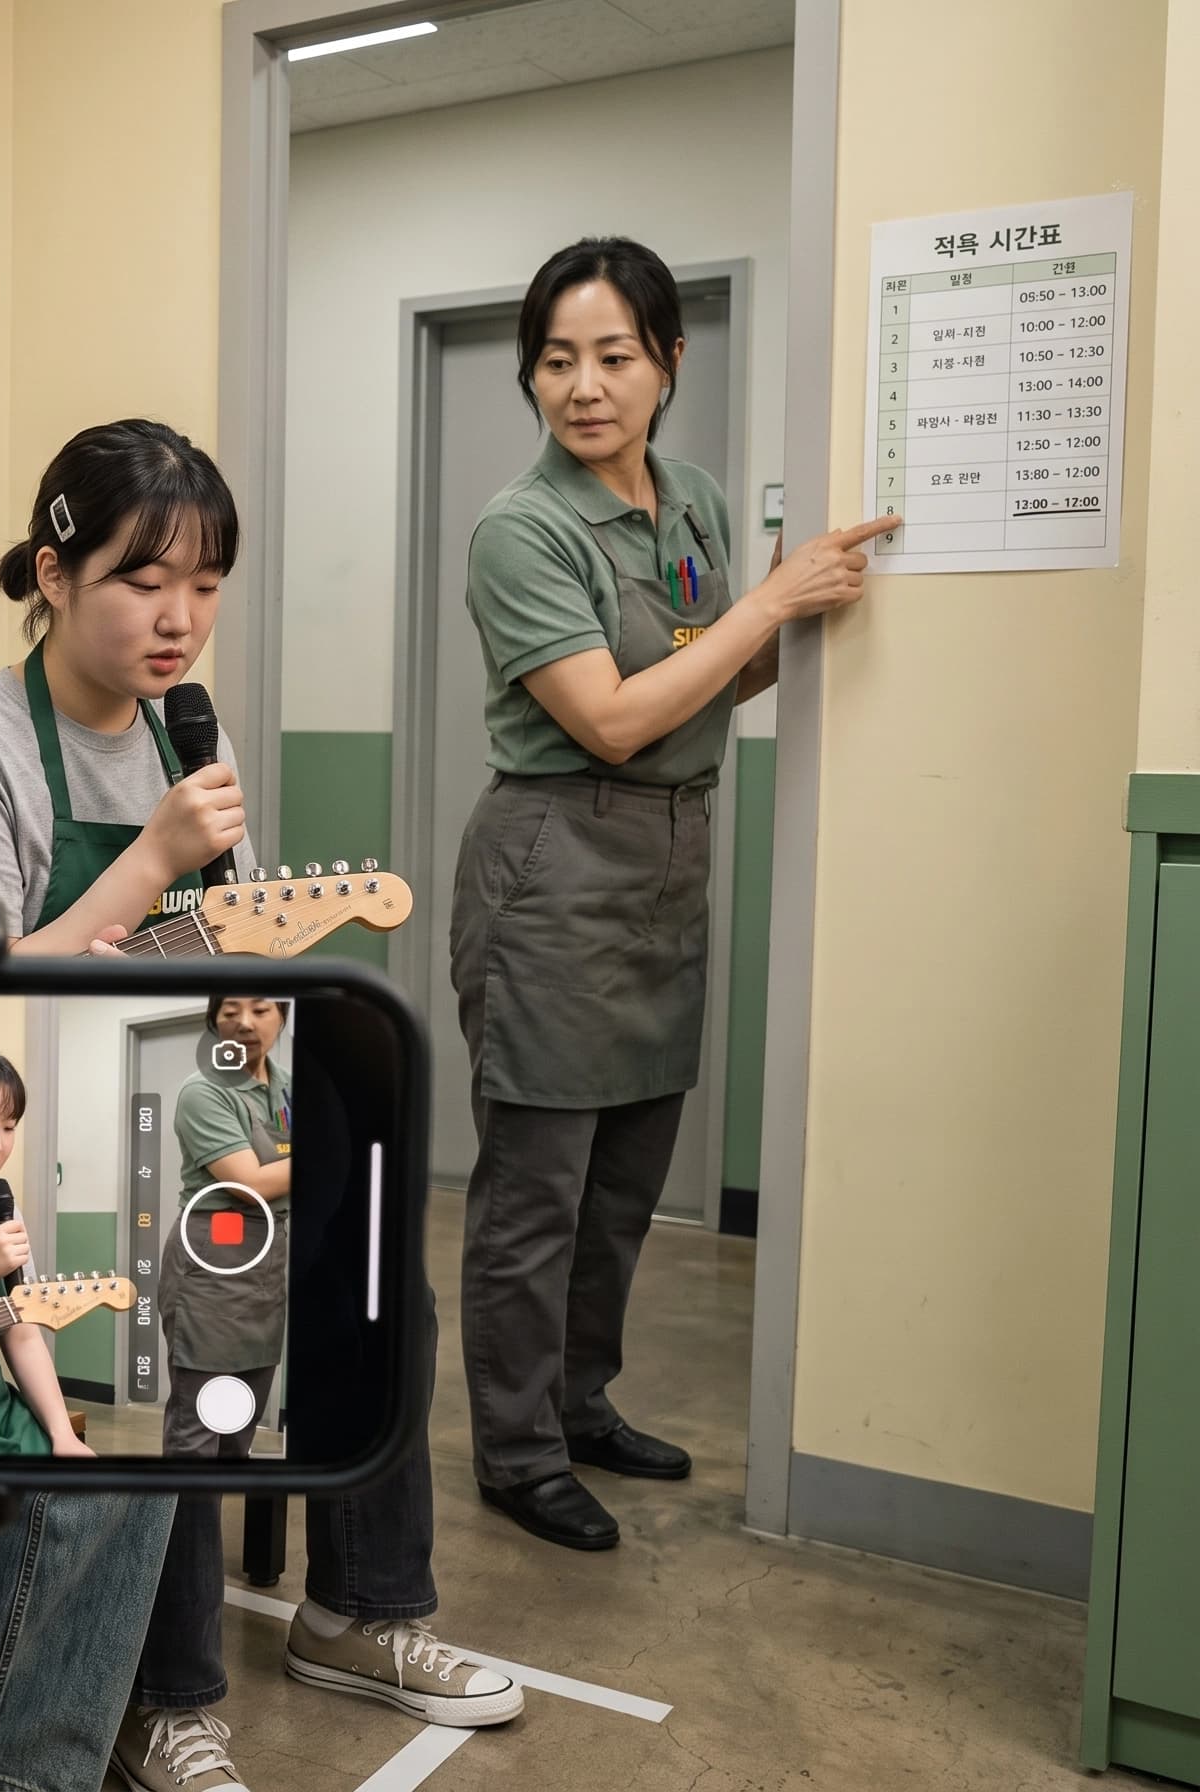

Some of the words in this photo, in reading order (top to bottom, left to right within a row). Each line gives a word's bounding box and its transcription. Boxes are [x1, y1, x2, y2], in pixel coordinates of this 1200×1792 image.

[989, 223, 1062, 252] 시간표
[893, 305, 898, 315] 1
[891, 334, 898, 345] 2
[1020, 320, 1054, 332] 10:00
[1070, 315, 1106, 328] 12:00
[890, 362, 897, 373] 3
[1019, 350, 1054, 362] 10:50
[1069, 345, 1104, 358] 12:30
[889, 391, 897, 401] 4
[1019, 380, 1053, 392] 13:00
[1068, 376, 1103, 388] 14:00
[889, 420, 896, 430] 5
[1017, 409, 1051, 422] 11:30
[1067, 405, 1102, 419] 13:30
[888, 448, 895, 459] 6
[1016, 439, 1050, 451] 12:50
[1066, 435, 1101, 448] 12:00
[887, 477, 894, 488] 7
[1065, 466, 1100, 478] 12:00
[887, 505, 894, 516] 8
[886, 533, 893, 544] 9
